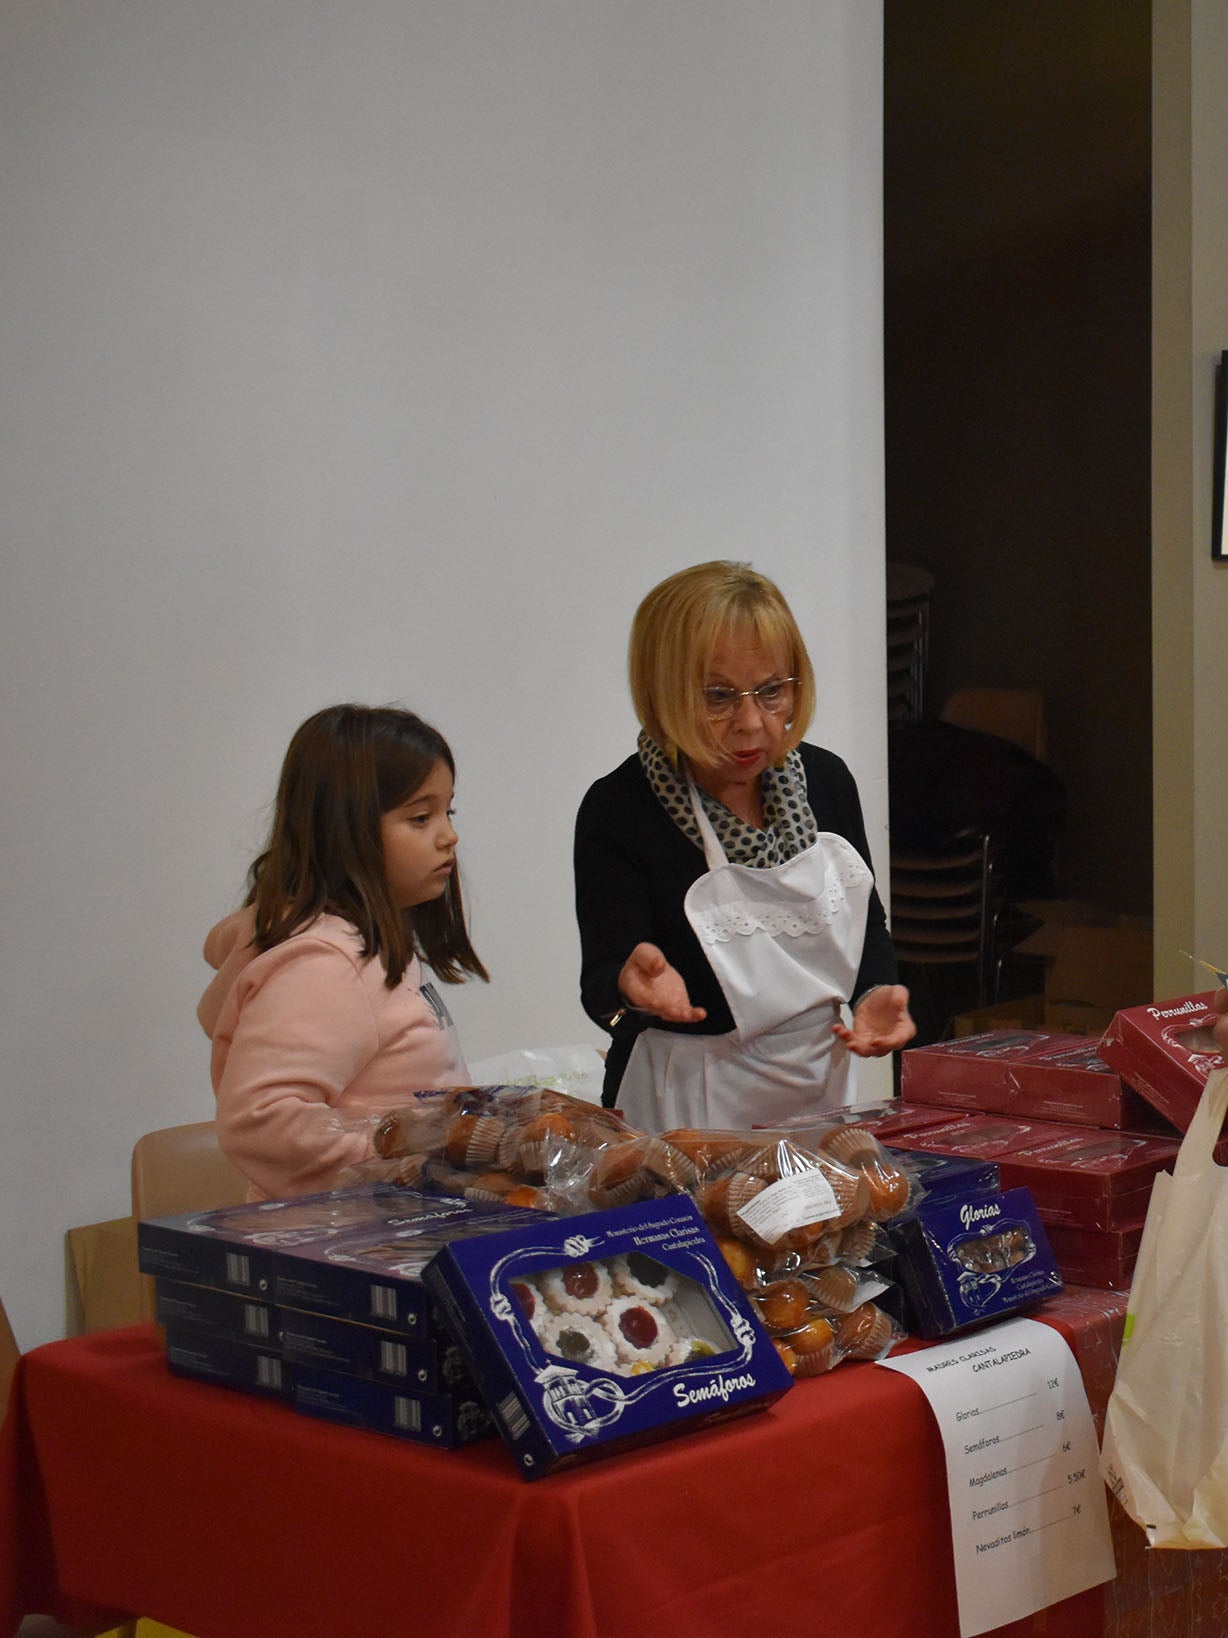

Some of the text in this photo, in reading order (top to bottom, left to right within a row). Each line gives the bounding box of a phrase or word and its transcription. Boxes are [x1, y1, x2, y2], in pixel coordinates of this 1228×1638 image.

[1146, 1000, 1209, 1020] Perrunillas
[960, 1203, 1001, 1231] Glorias
[669, 1226, 700, 1238] Clarisas
[926, 1346, 997, 1373] MADRES CLARISAS
[972, 1348, 1031, 1372] CANTALAPIEDRA
[673, 1373, 756, 1408] Semáforos
[956, 1377, 1060, 1422] Glorias 12€
[964, 1409, 1065, 1454] Semáforos 8€
[969, 1441, 1071, 1488] Magdalenas 6€
[972, 1501, 1009, 1520] Perrunillas
[976, 1504, 1081, 1554] Nevaditos limón 7€
